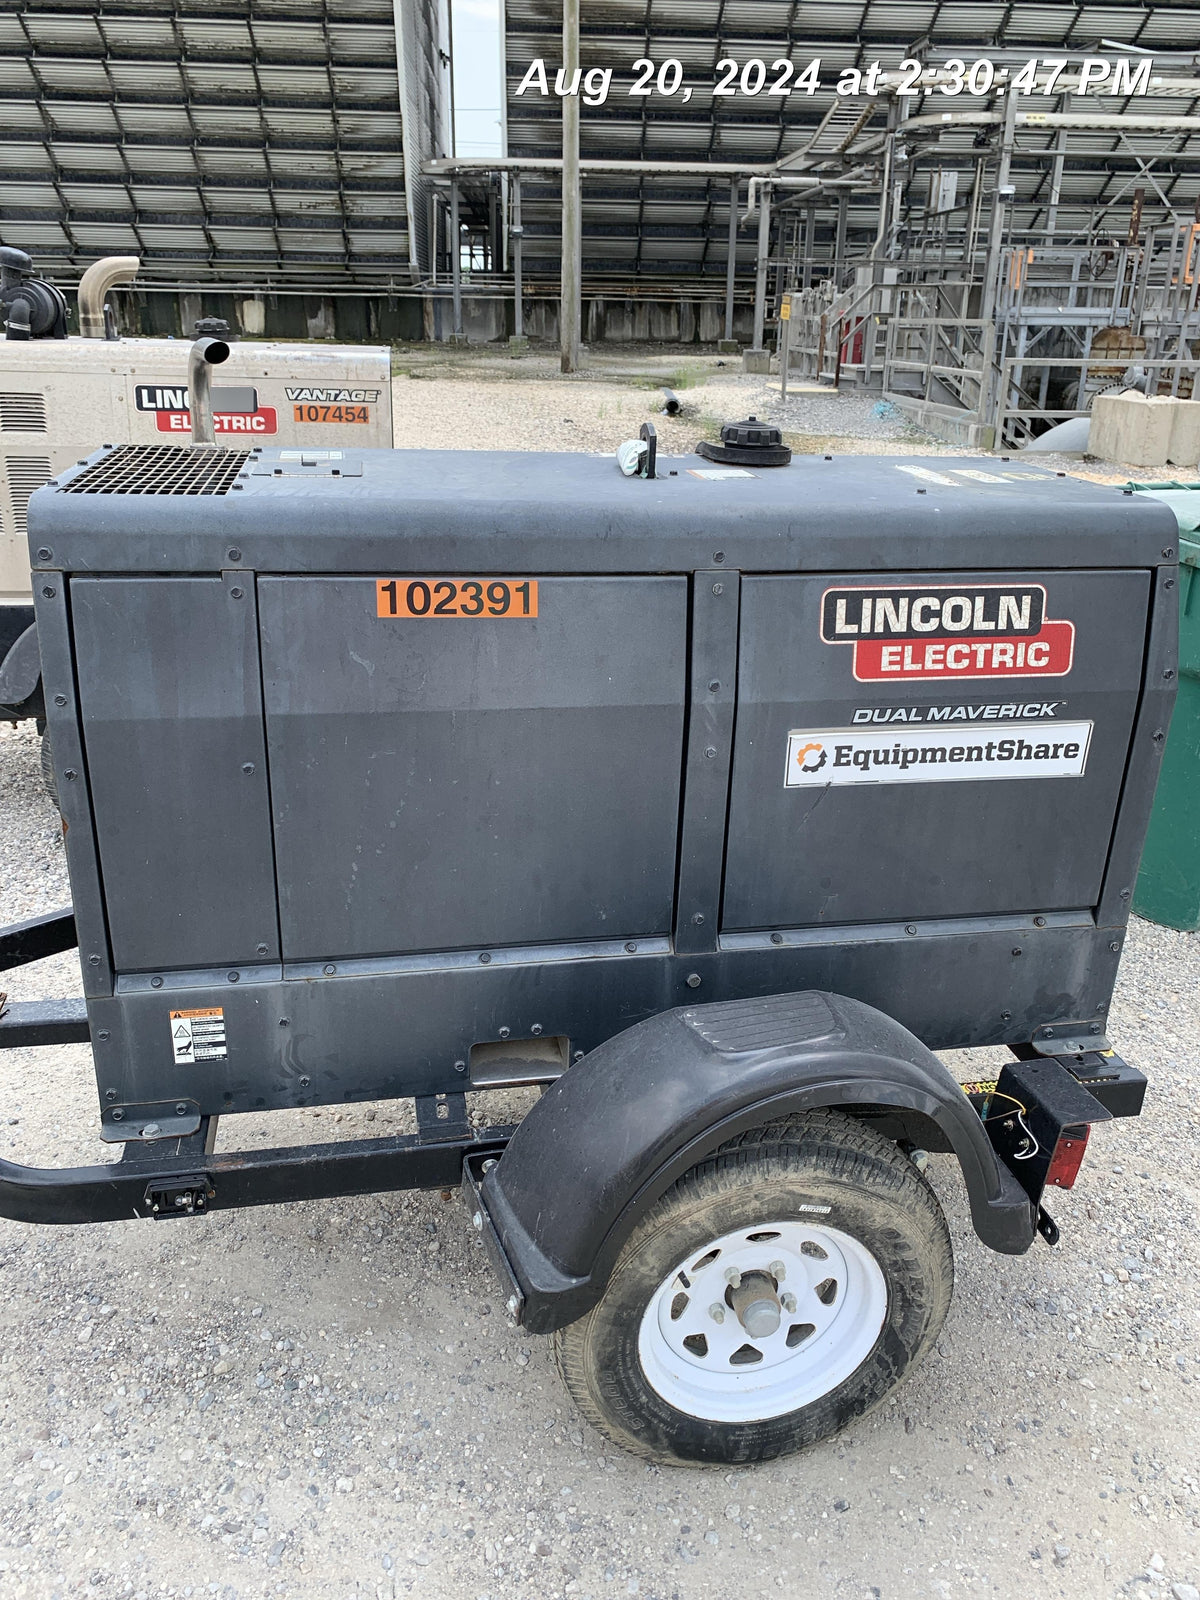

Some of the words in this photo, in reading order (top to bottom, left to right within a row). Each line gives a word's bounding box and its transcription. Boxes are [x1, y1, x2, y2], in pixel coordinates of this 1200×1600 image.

[285, 387, 381, 403] VANTAGE
[169, 414, 266, 431] ELCTRIC
[296, 405, 368, 422] 107454
[381, 580, 530, 616] 102391
[835, 594, 1032, 634] LINCOLN
[881, 641, 1050, 672] ELECTRIC
[852, 706, 923, 724] DUAL
[926, 702, 1060, 721] MAVERICK
[833, 739, 1080, 770] EquipmentShare
